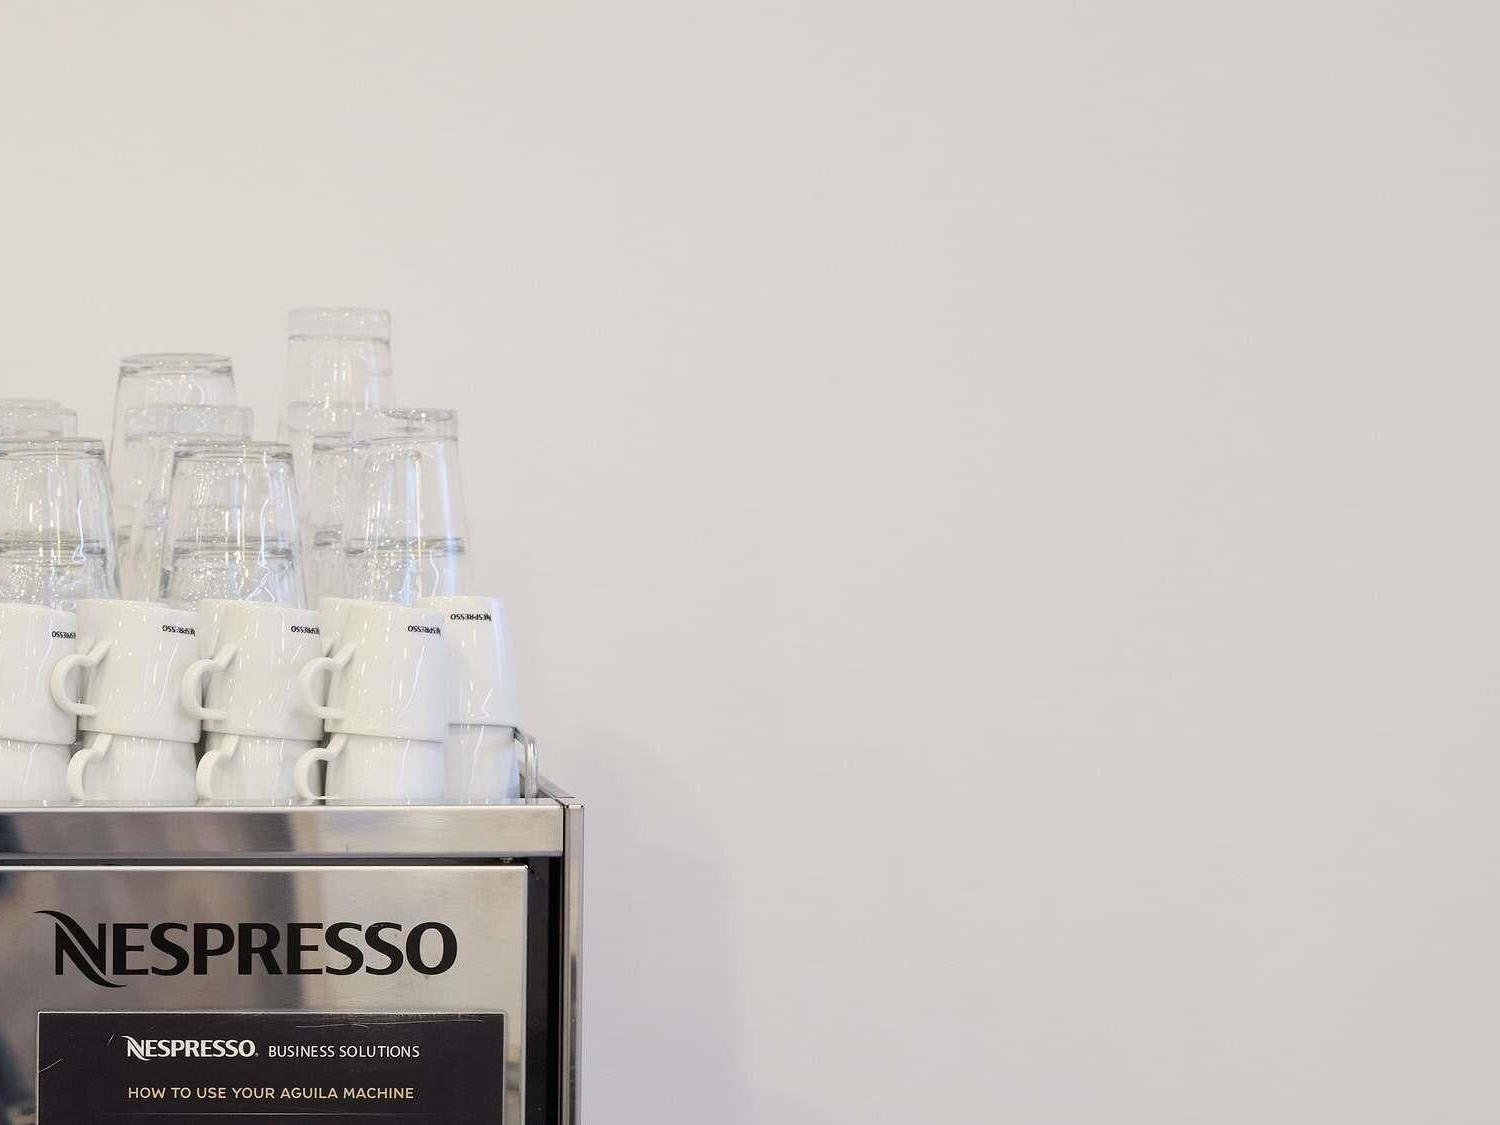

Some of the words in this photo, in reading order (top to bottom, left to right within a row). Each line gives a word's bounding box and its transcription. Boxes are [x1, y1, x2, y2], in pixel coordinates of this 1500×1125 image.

[34, 910, 458, 988] NESPRESSO
[120, 1035, 258, 1062] NESPRESSO
[268, 1045, 335, 1058] BUSINESS
[338, 1045, 420, 1058] SOLUTIONS
[128, 1086, 167, 1099] HOW
[170, 1087, 192, 1099] TO
[196, 1086, 227, 1099] USE
[231, 1086, 276, 1099] YOUR
[279, 1087, 339, 1099] AGUILA
[343, 1087, 415, 1100] MACHINE
